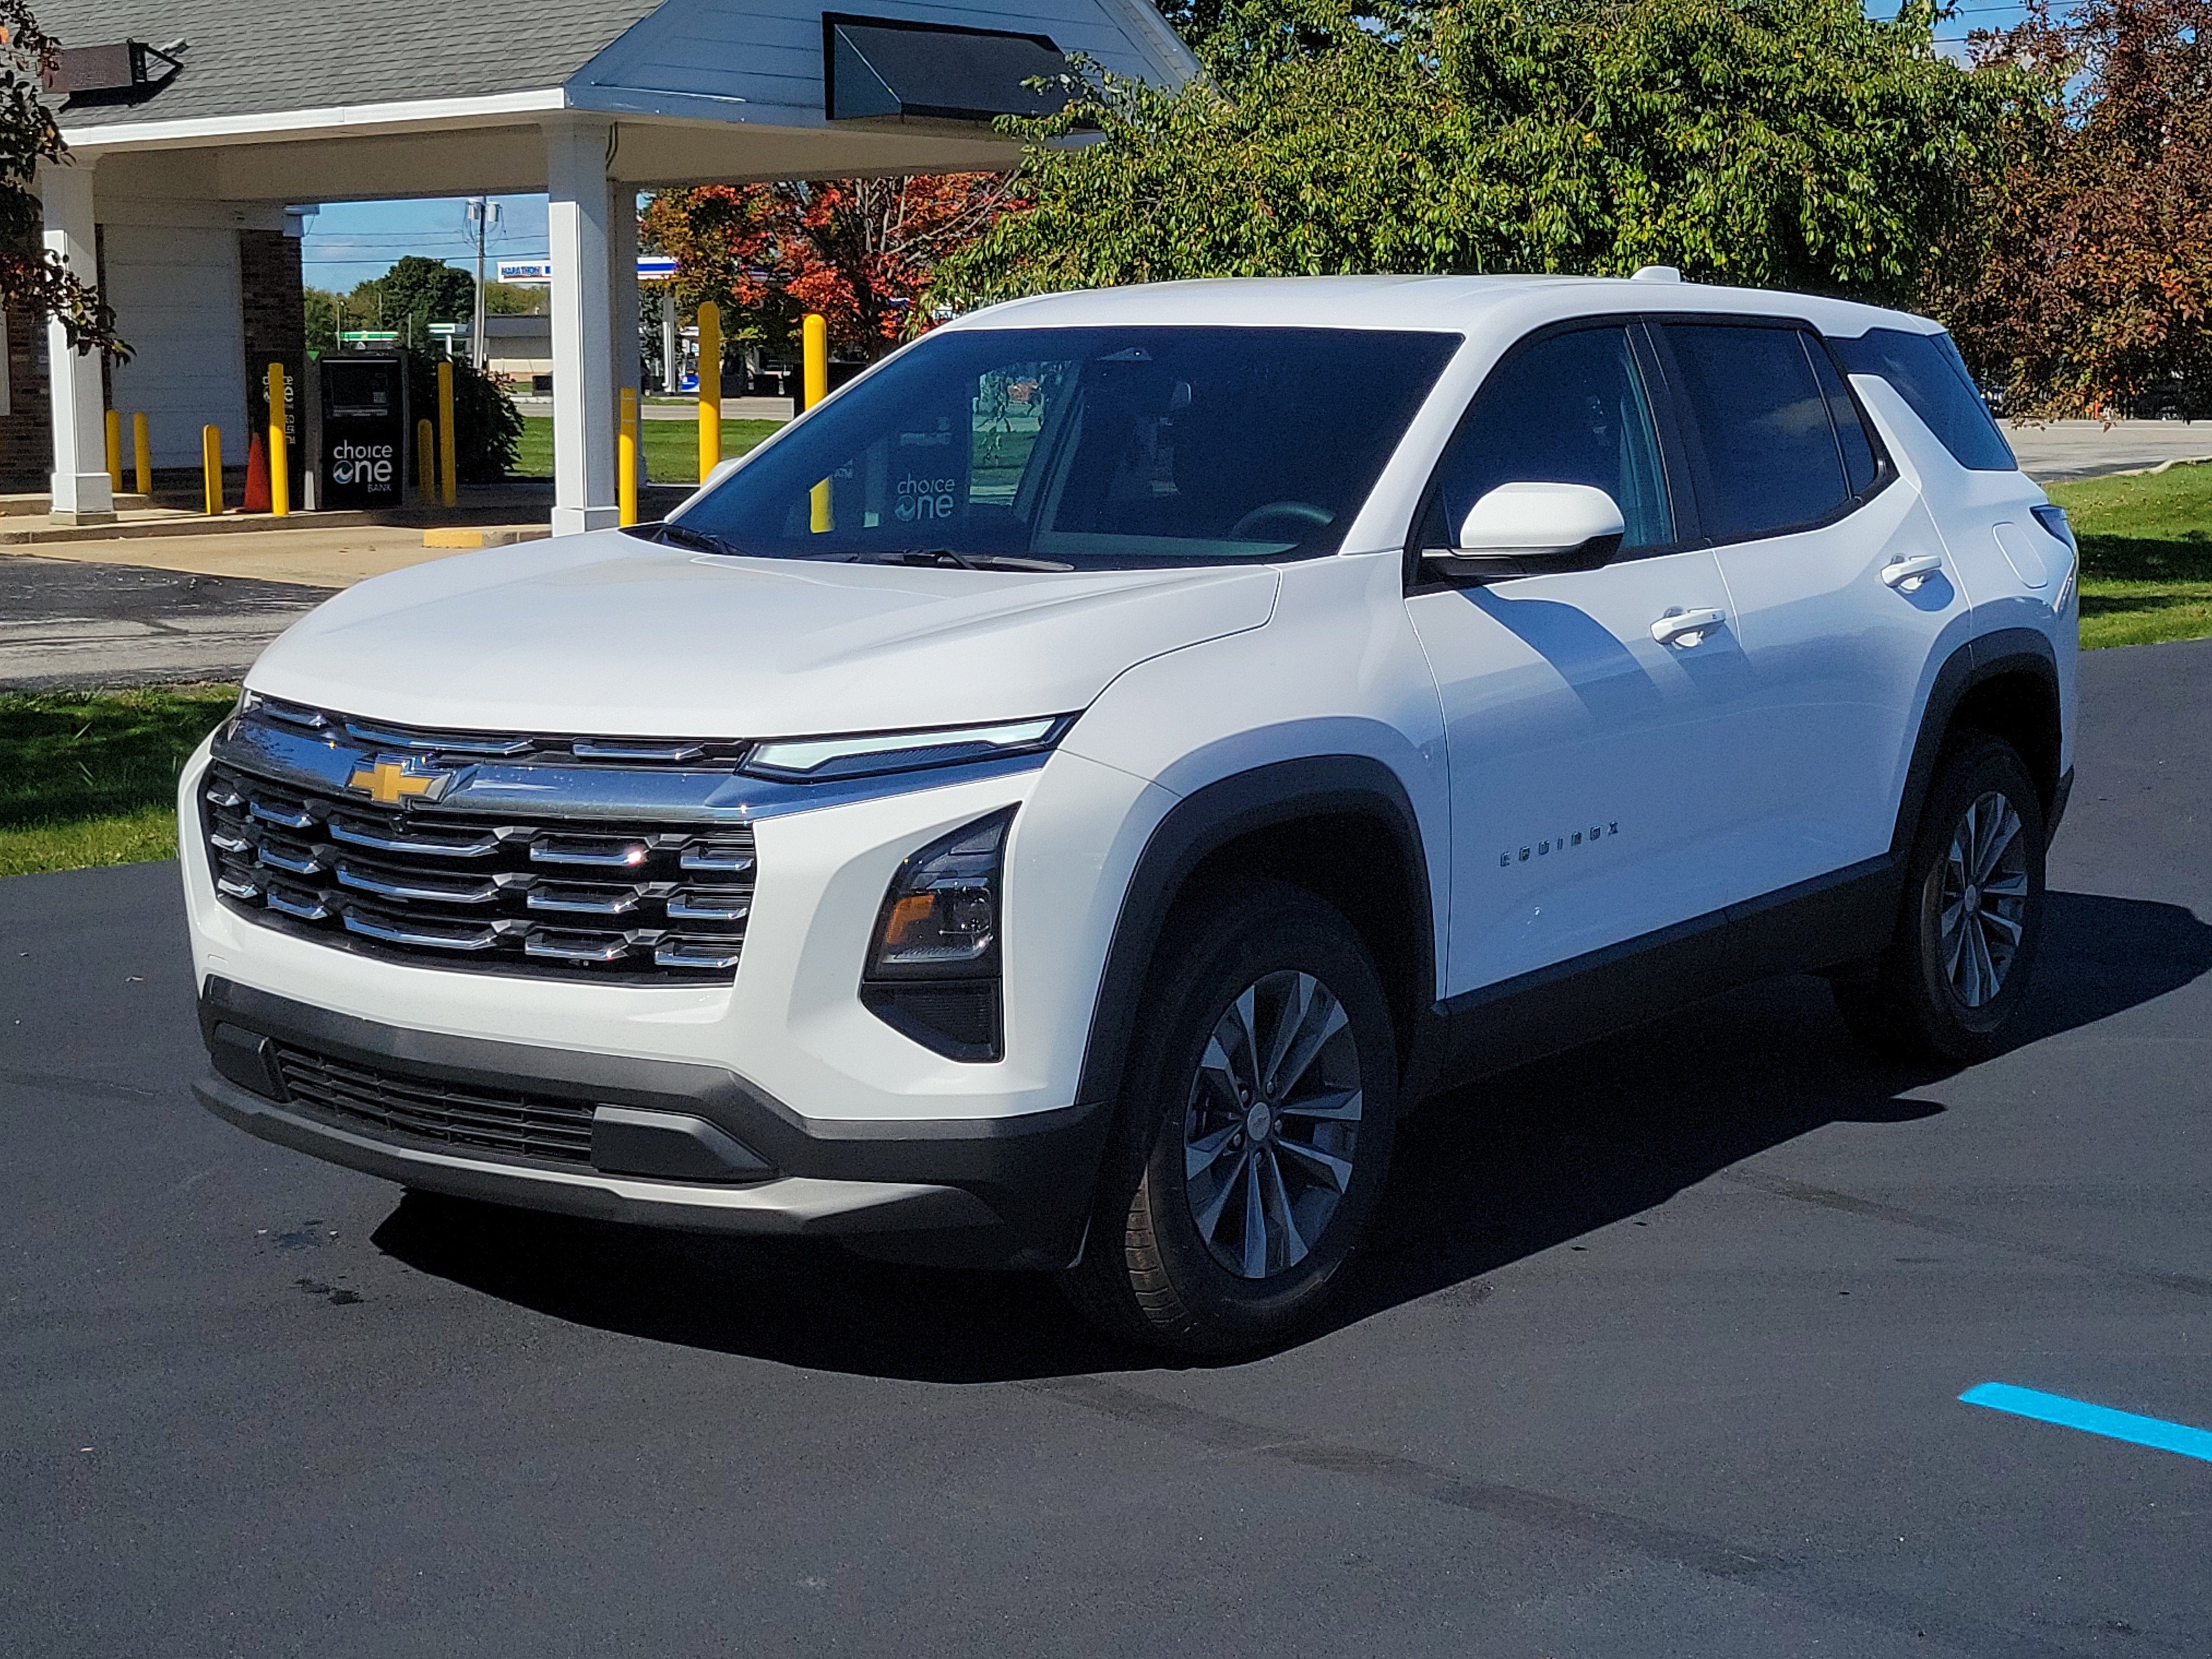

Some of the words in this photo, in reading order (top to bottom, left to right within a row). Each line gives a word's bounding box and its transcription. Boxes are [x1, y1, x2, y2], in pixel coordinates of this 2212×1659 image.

[333, 439, 393, 459] choice
[368, 483, 392, 493] BANK
[898, 473, 955, 494] choice
[1500, 821, 1618, 867] EQUINOX
